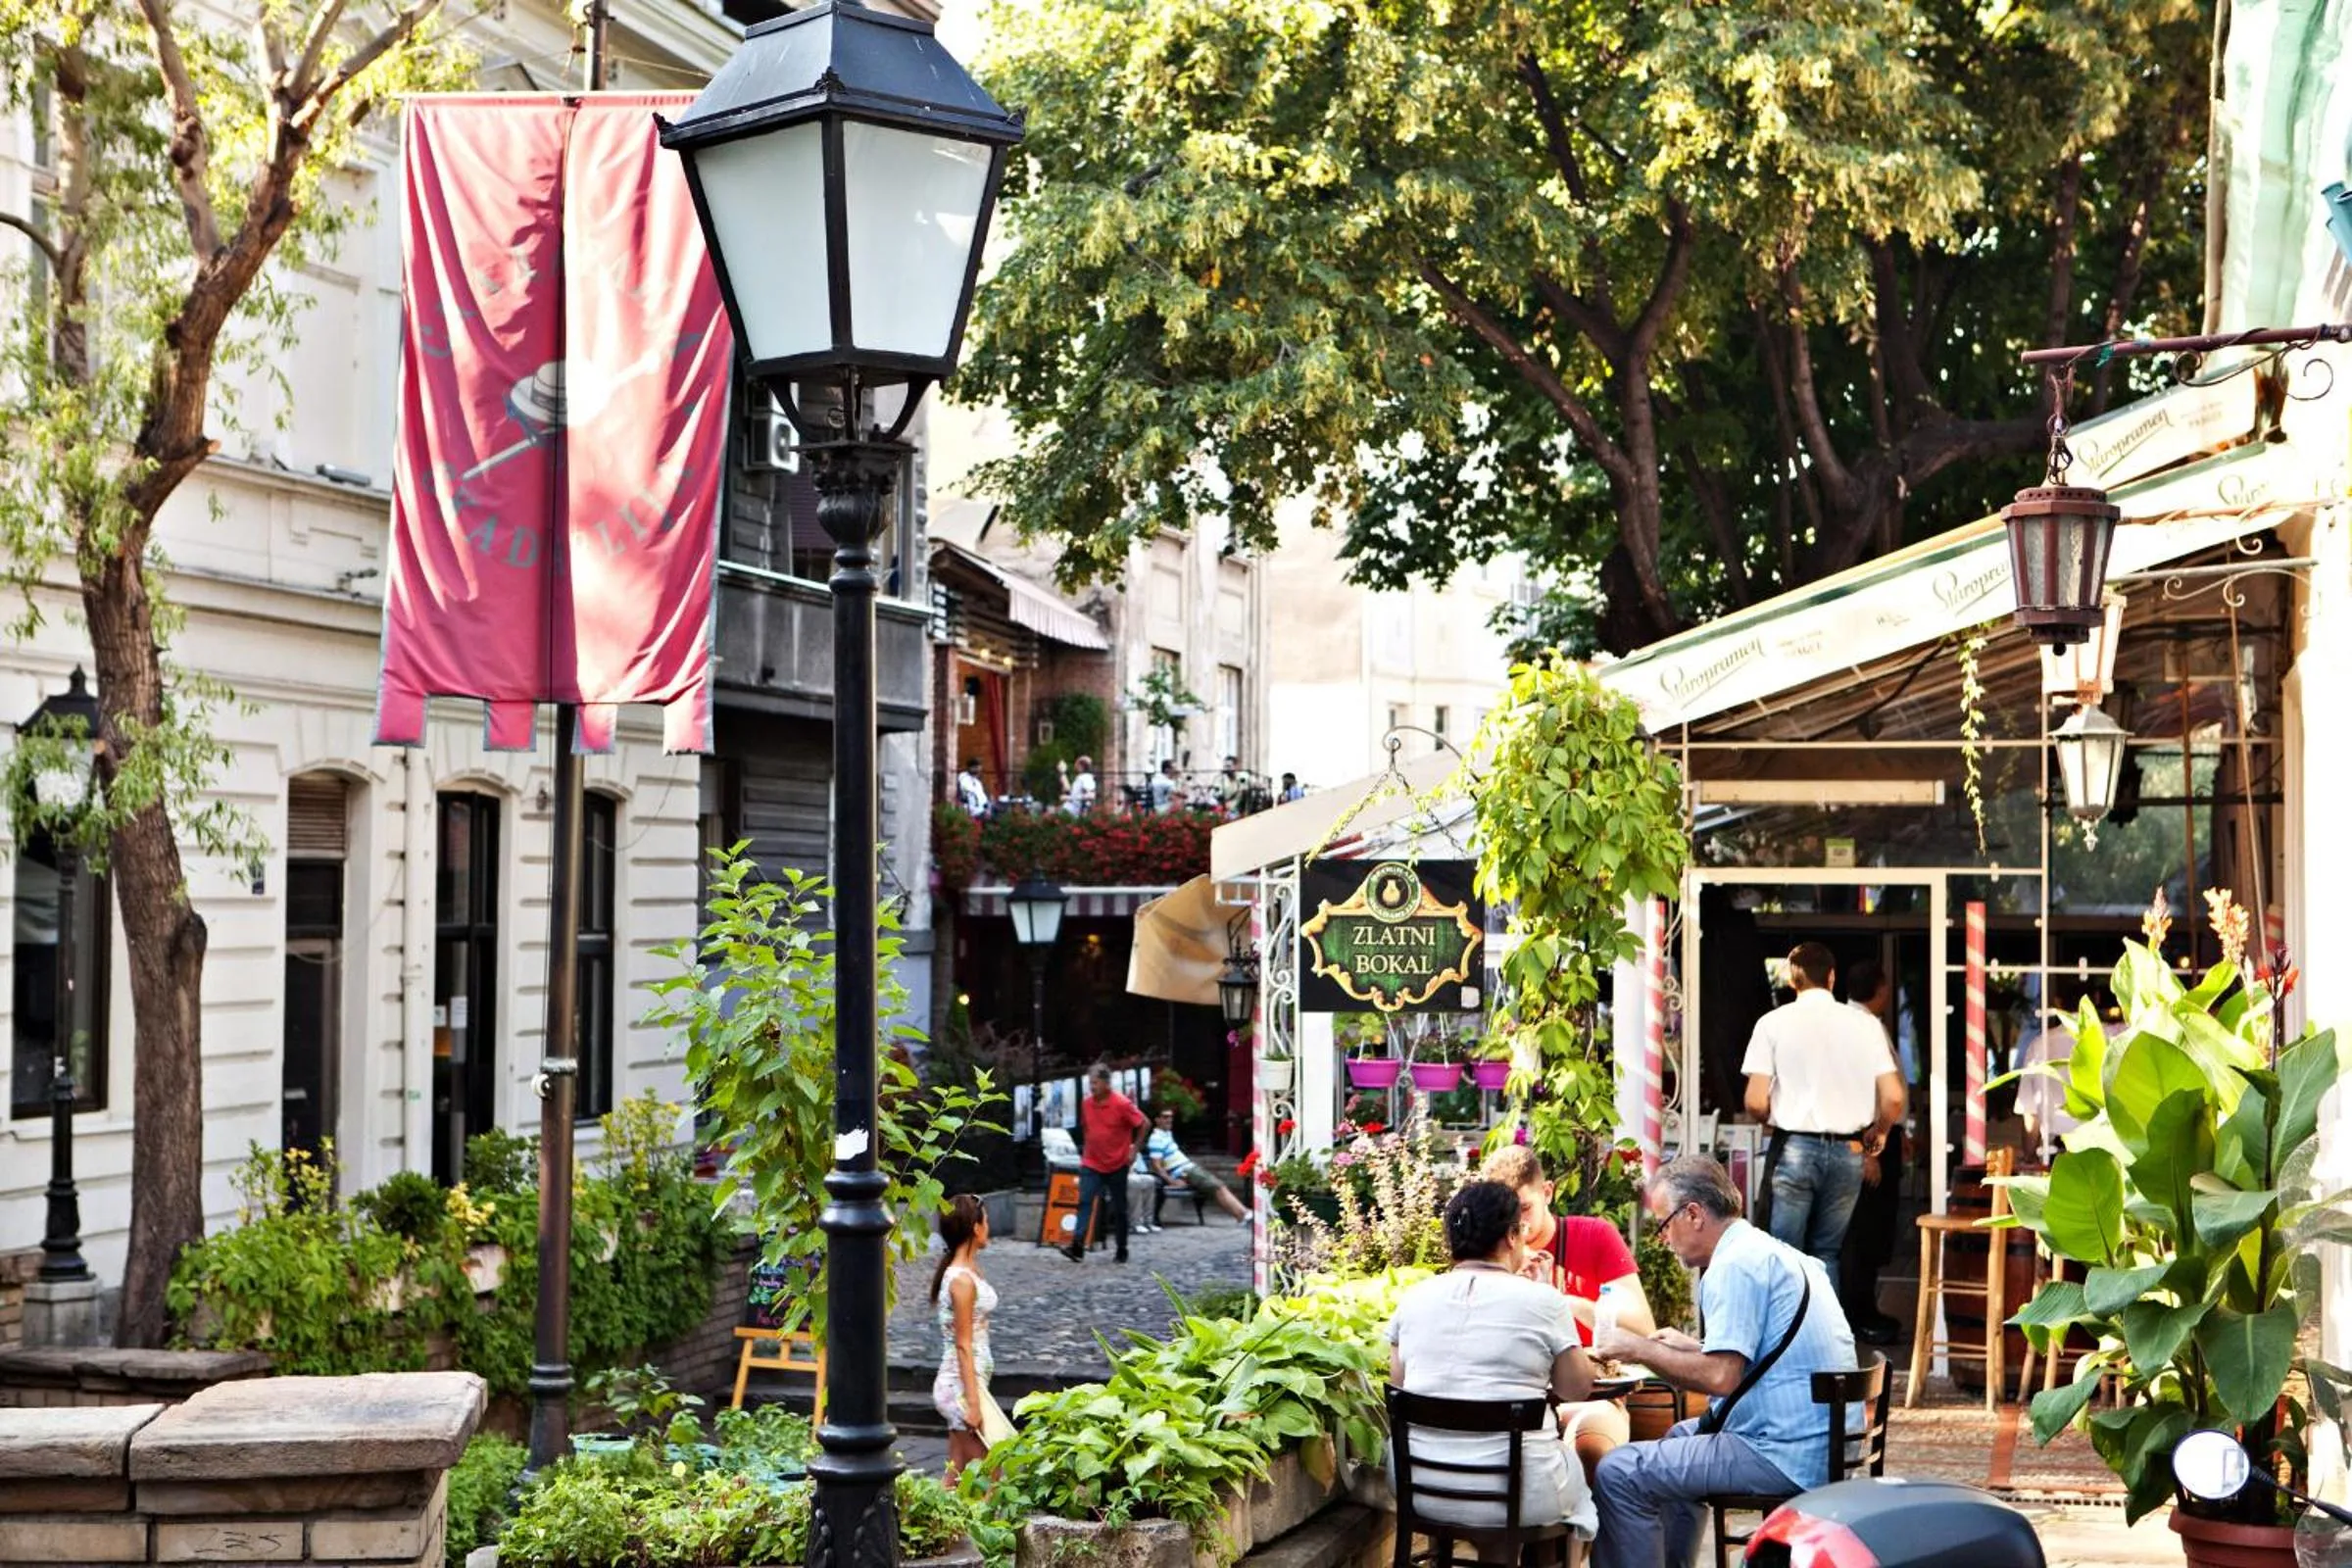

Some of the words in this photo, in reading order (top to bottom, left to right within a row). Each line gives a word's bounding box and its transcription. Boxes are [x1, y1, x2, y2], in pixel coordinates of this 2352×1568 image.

[2077, 409, 2174, 476] Staropramen
[1660, 637, 1767, 706] Staropramen
[1352, 925, 1436, 947] ZLATNI
[1354, 955, 1434, 975] BOKAL
